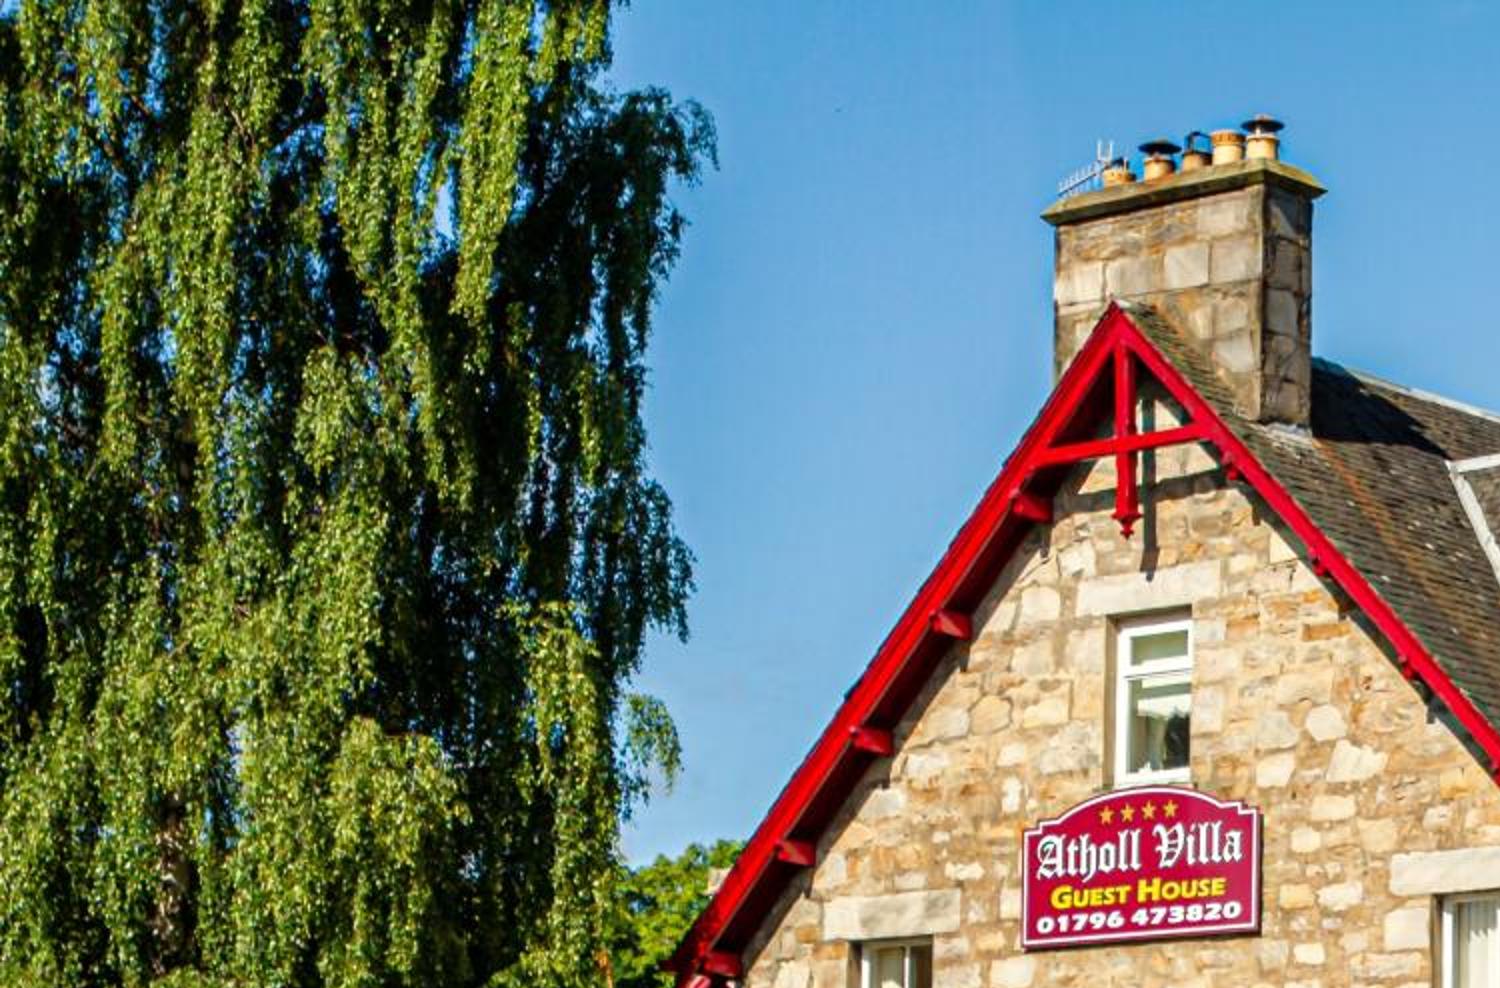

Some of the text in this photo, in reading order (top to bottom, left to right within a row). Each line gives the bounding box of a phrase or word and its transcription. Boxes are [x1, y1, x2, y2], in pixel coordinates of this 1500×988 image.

[1037, 820, 1242, 883] Atholl Villa
[1051, 878, 1227, 909] GUEST HOUSE
[1037, 902, 1241, 934] 01796 473820
